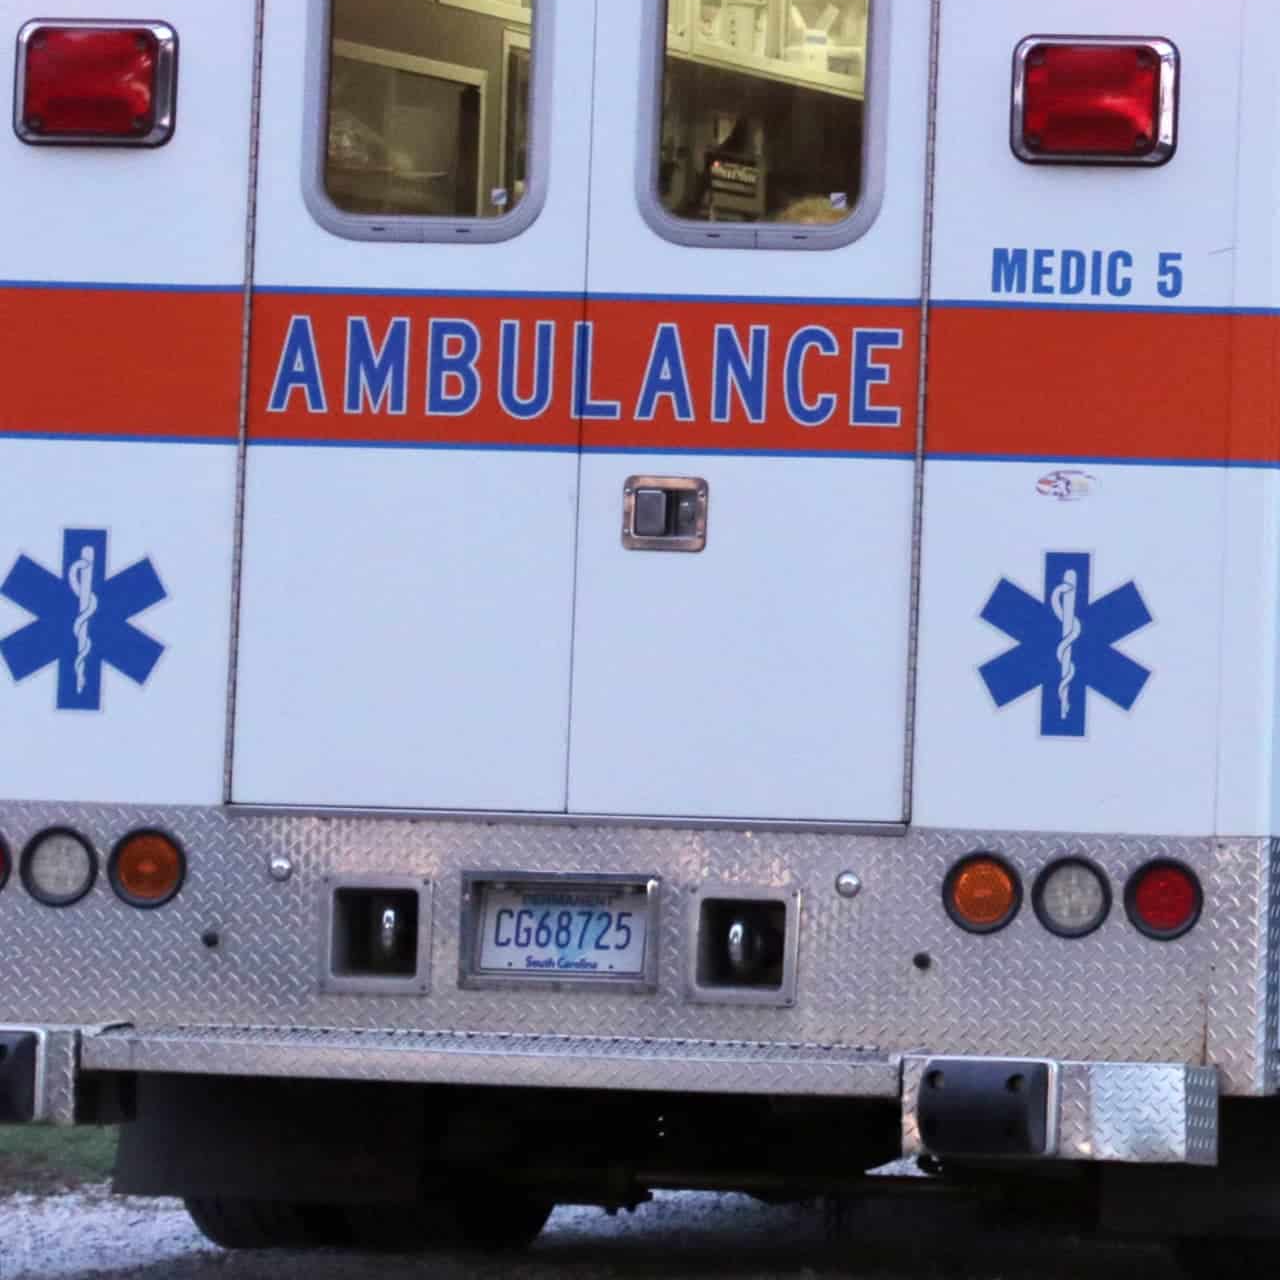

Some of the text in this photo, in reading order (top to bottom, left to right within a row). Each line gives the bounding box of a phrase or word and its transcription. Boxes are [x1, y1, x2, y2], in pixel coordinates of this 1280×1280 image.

[991, 247, 1184, 298] MEDIC 5
[267, 315, 904, 427] AMBULANCE
[494, 908, 633, 951] CG68725
[525, 955, 598, 970] South Carolina
